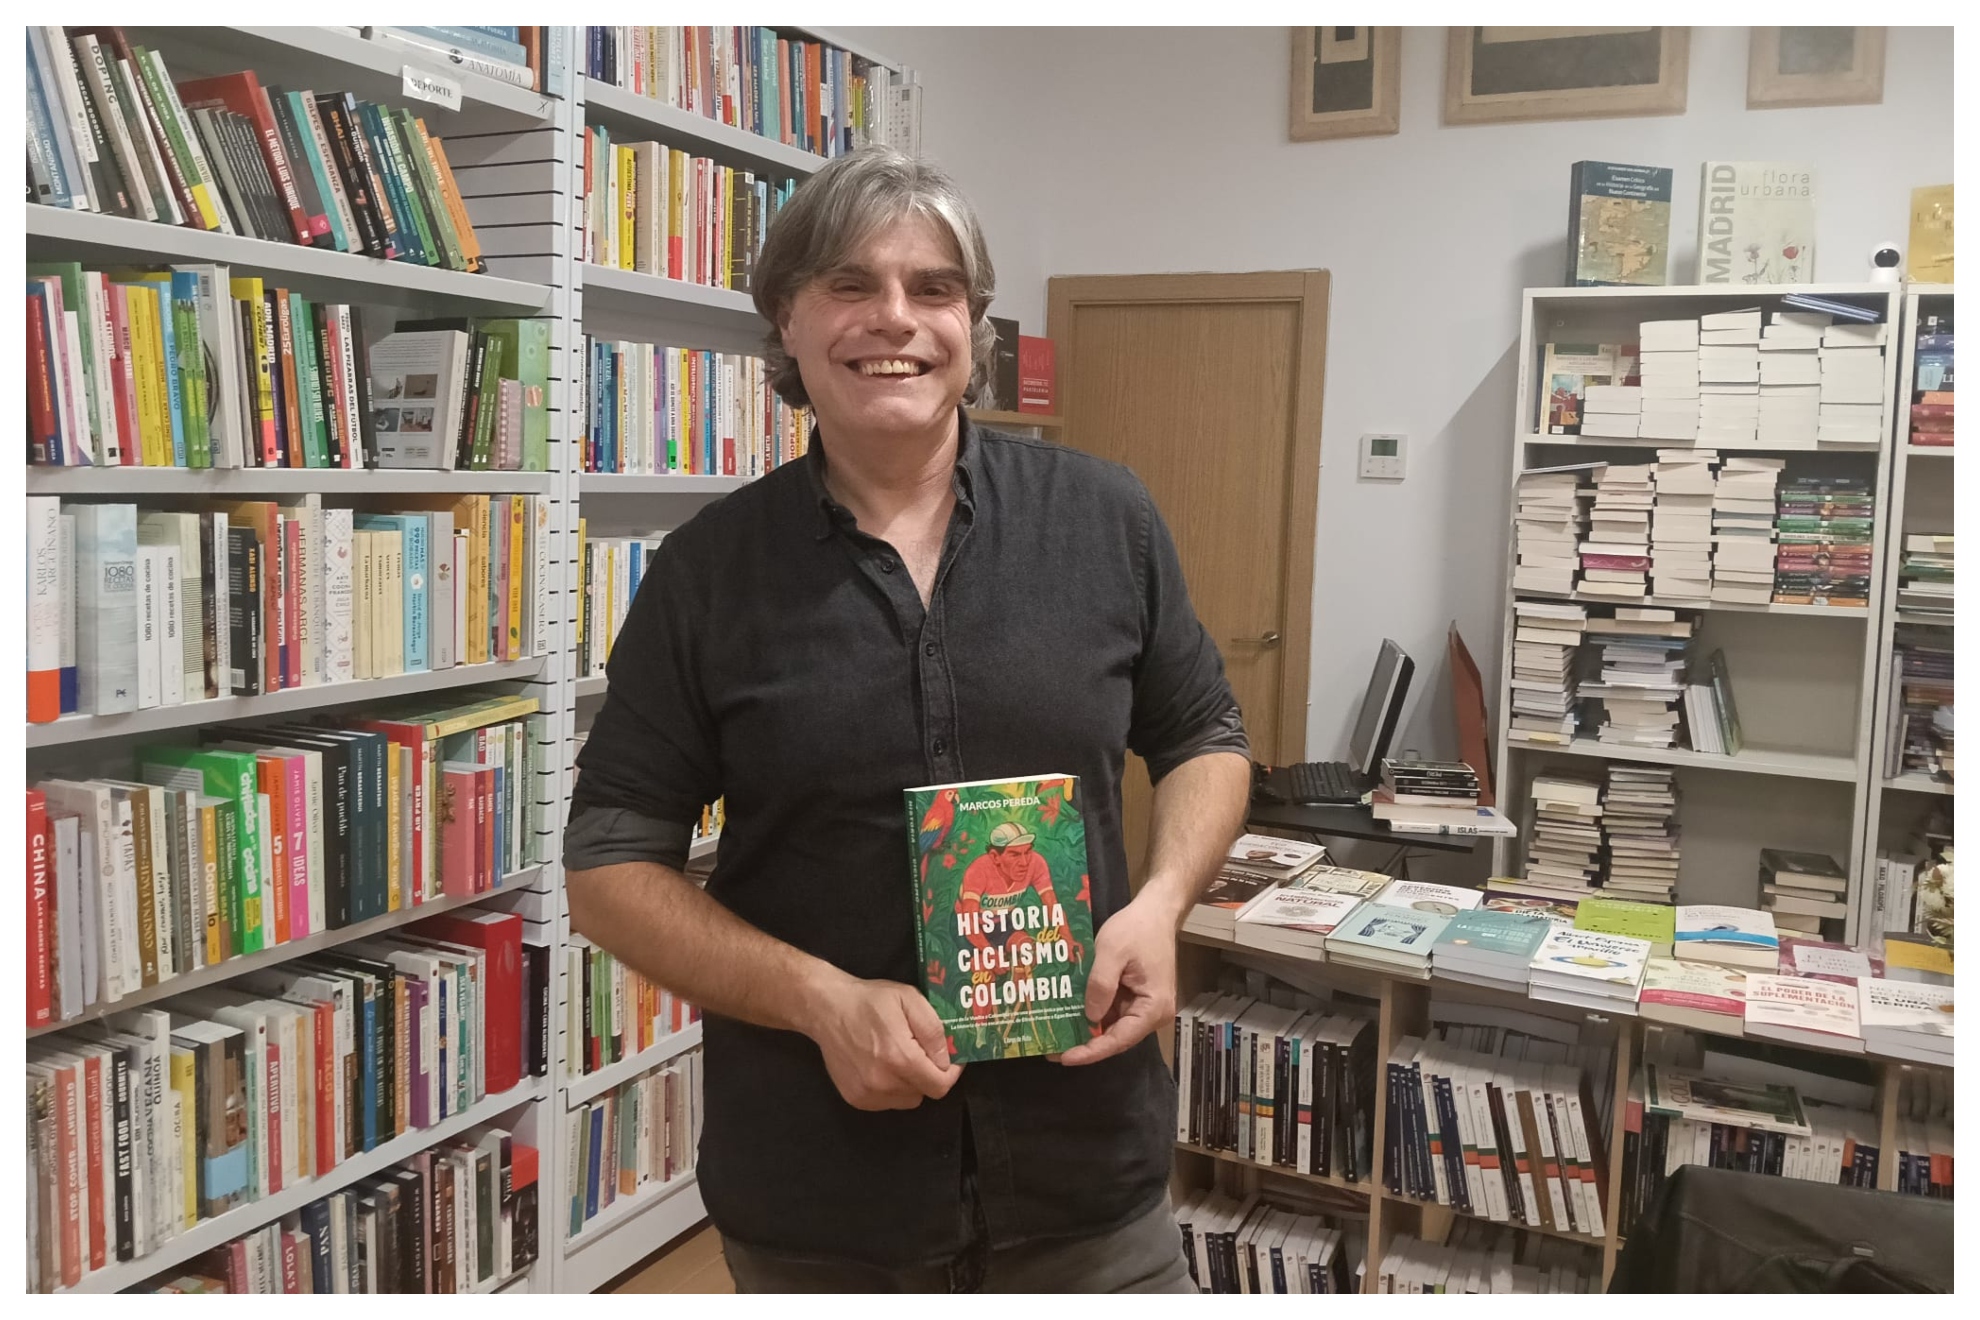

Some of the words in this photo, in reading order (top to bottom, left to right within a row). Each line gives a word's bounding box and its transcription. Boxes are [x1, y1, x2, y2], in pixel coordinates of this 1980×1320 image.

[140, 55, 148, 65] EL
[143, 66, 154, 80] GOL
[467, 60, 522, 84] ANATOMÍA
[91, 45, 117, 104] DOPING
[410, 77, 453, 98] DEPORTE
[159, 102, 171, 120] VIDA
[163, 139, 170, 148] LA
[265, 128, 275, 137] EL
[305, 97, 319, 131] GOLPES
[321, 143, 341, 194] ESPERANZA
[267, 137, 285, 166] MÉTODO
[351, 131, 366, 162] walking
[381, 116, 400, 154] INVASIÓN
[397, 163, 414, 194] CAMPO
[276, 166, 290, 182] LUIS
[429, 161, 445, 185] TRIPLE
[1763, 169, 1810, 184] flora
[183, 188, 193, 202] 100
[281, 183, 301, 210] ENRIQUE
[1740, 182, 1810, 197] urbana
[1706, 164, 1736, 283] MADRID
[263, 302, 273, 324] ADN
[121, 326, 130, 350] MARCO
[264, 325, 276, 364] MADRID
[123, 351, 133, 379] PANTANI
[168, 344, 178, 376] PEDRO
[309, 366, 321, 390] COLORES
[345, 354, 355, 394] PIZARRAS
[172, 379, 181, 410] BRAVO
[349, 413, 359, 443] FÚTBOL
[766, 452, 770, 461] LA
[480, 509, 488, 539] ciencia
[43, 508, 57, 587] ARGUIÑANO
[248, 547, 256, 564] XABI
[36, 547, 47, 596] KARLOS
[104, 566, 134, 577] 1080
[249, 566, 257, 592] ALONSO
[298, 528, 308, 605] HERMANAS
[538, 551, 547, 592] COCINA
[144, 584, 151, 593] de
[167, 582, 174, 591] de
[538, 592, 547, 635] CASERA
[144, 623, 152, 641] 1080
[167, 620, 175, 638] 1080
[478, 736, 486, 752] BAO
[337, 766, 347, 785] Pan
[311, 780, 319, 806] Jamie
[338, 787, 347, 800] de
[391, 775, 400, 815] exprés!
[959, 799, 1001, 811] MARCOS
[1002, 796, 1041, 807] PEREDA
[311, 808, 319, 834] Oliver
[336, 801, 347, 836] pueblo
[1457, 826, 1478, 834] ISLAS
[293, 832, 304, 851] 7
[392, 825, 400, 861] vegano
[32, 833, 45, 900] CHINA
[122, 842, 134, 872] TAPAS
[241, 848, 257, 895] cocina
[293, 855, 305, 887] IDEAS
[908, 800, 916, 843] HISTORIA
[912, 858, 920, 903] CICLISMO
[916, 914, 924, 963] COLOMBIA
[36, 901, 44, 917] LAS
[1275, 896, 1340, 909] NATURAL
[142, 900, 154, 949] COCINA
[956, 904, 1065, 936] HISTORIA
[1466, 926, 1533, 939] ESCRITURA
[1036, 926, 1060, 944] del
[1558, 931, 1591, 941] Albert
[957, 940, 1069, 973] CICLISMO
[971, 971, 992, 985] en
[959, 975, 1073, 1009] COLOMBIA
[1753, 990, 1855, 1010] SUPLEMENTACIÓN
[1776, 987, 1815, 997] PODER
[1871, 1000, 1934, 1011] HERIDA
[1894, 997, 1930, 1006] UNA
[88, 1070, 99, 1104] abuela
[116, 1061, 127, 1103] GOURMETS
[144, 1057, 153, 1116] VEGANA
[152, 1055, 161, 1105] QUINOA
[269, 1061, 280, 1114] APERITIVO
[324, 1054, 334, 1103] TACOS
[67, 1082, 77, 1136] ANSIEDAD
[91, 1121, 100, 1154] recetas
[117, 1120, 129, 1147] FOOD
[145, 1117, 154, 1156] COCINA
[69, 1149, 77, 1187] COMER
[118, 1149, 130, 1177] FAST
[70, 1192, 78, 1221] STOP
[319, 1225, 330, 1256] PAN
[285, 1246, 295, 1289] LOLA'S
[351, 1264, 360, 1288] PAN
